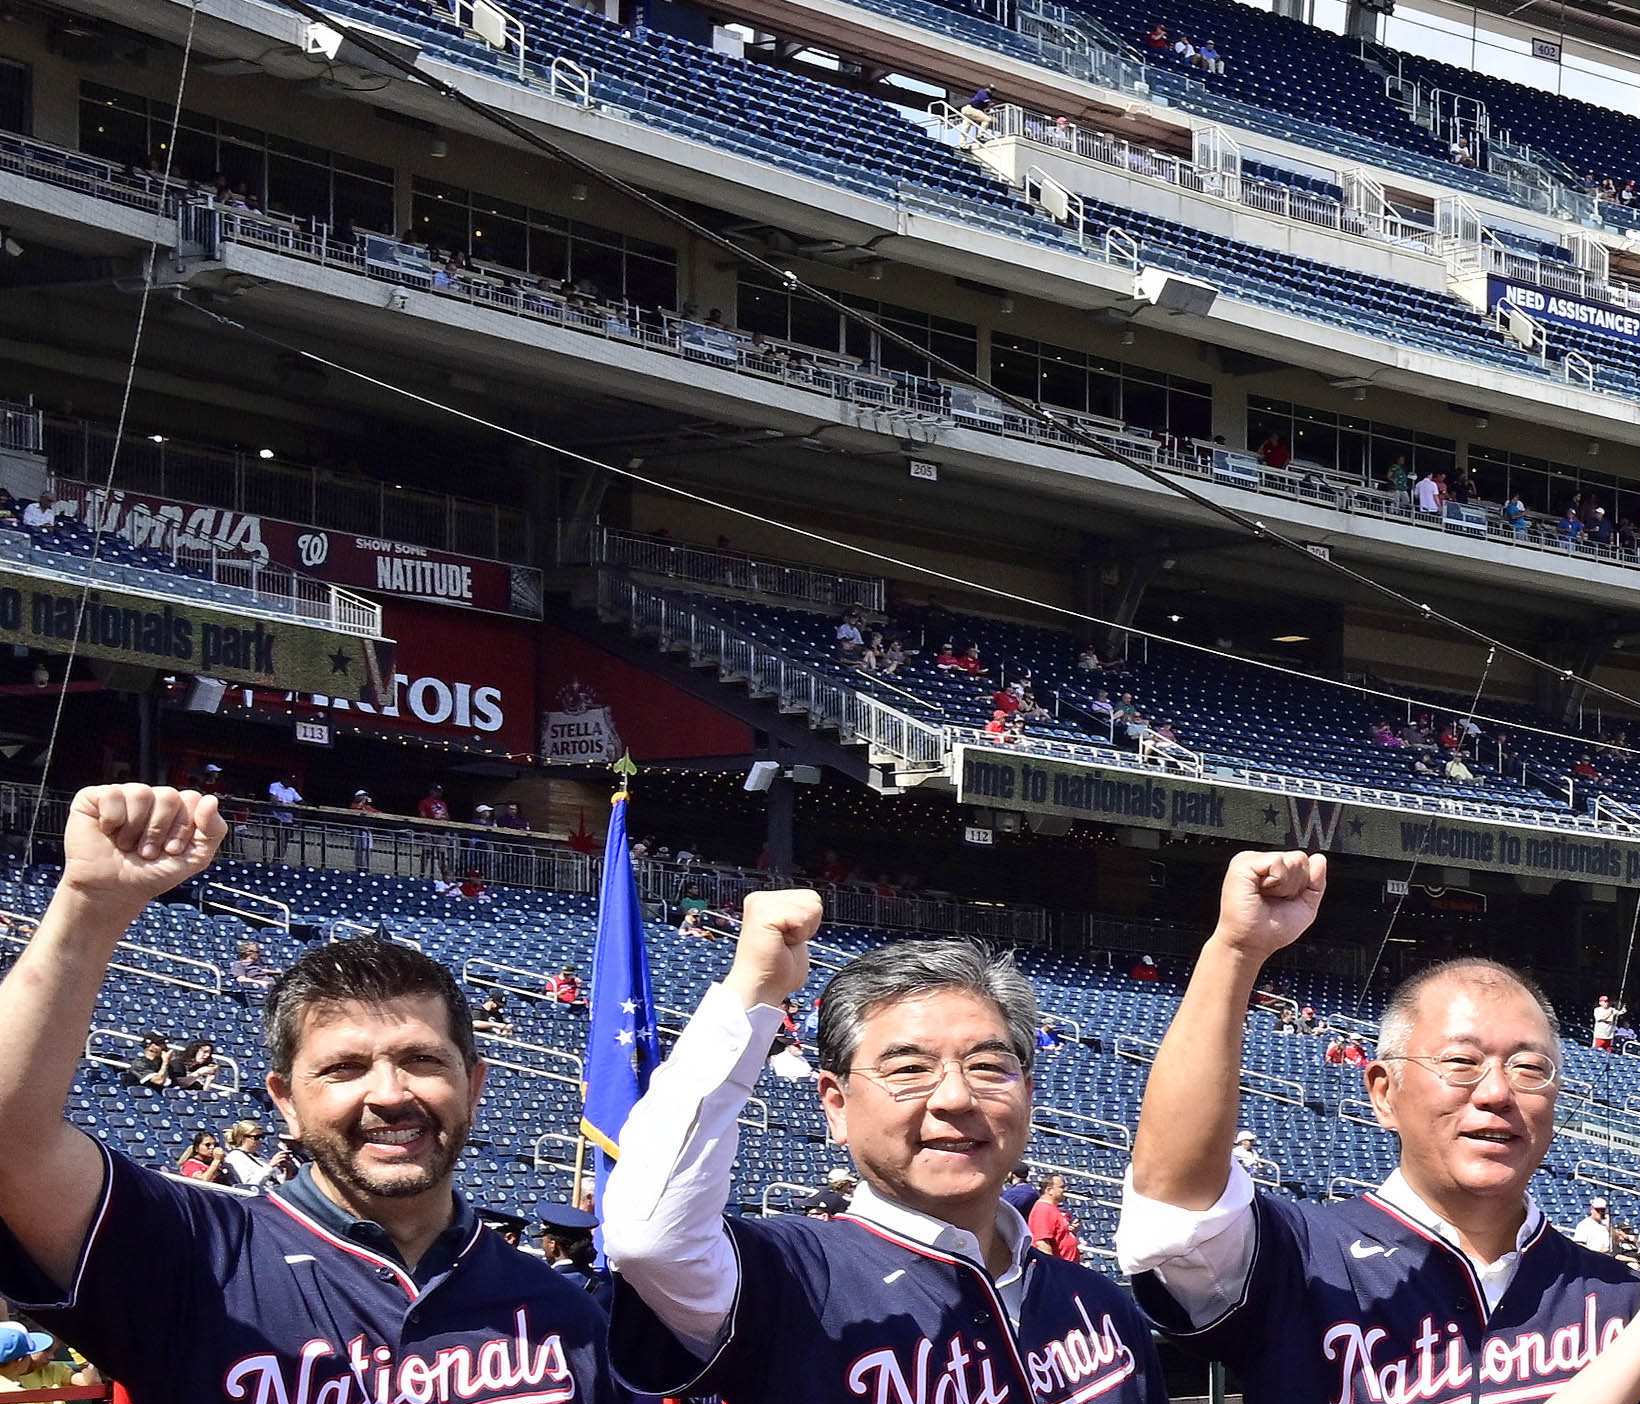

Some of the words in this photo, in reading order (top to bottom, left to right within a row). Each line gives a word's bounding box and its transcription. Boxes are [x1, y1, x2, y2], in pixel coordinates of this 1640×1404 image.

[1505, 284, 1545, 311] NEED
[1548, 298, 1640, 337] ASSISTANCE?
[355, 537, 391, 551] SHOW
[394, 542, 428, 557] SOME
[376, 555, 473, 599] NATITUDE
[31, 590, 194, 660] nationals
[201, 621, 274, 674] park
[302, 725, 324, 740] 113
[550, 722, 602, 739] STELLA
[550, 739, 604, 756] ARTOIS
[1022, 763, 1048, 804] to
[1054, 769, 1166, 819] nationals
[1172, 789, 1224, 828] park
[1401, 821, 1494, 863] welcome
[1500, 834, 1521, 866] to
[1526, 837, 1621, 879] nationals
